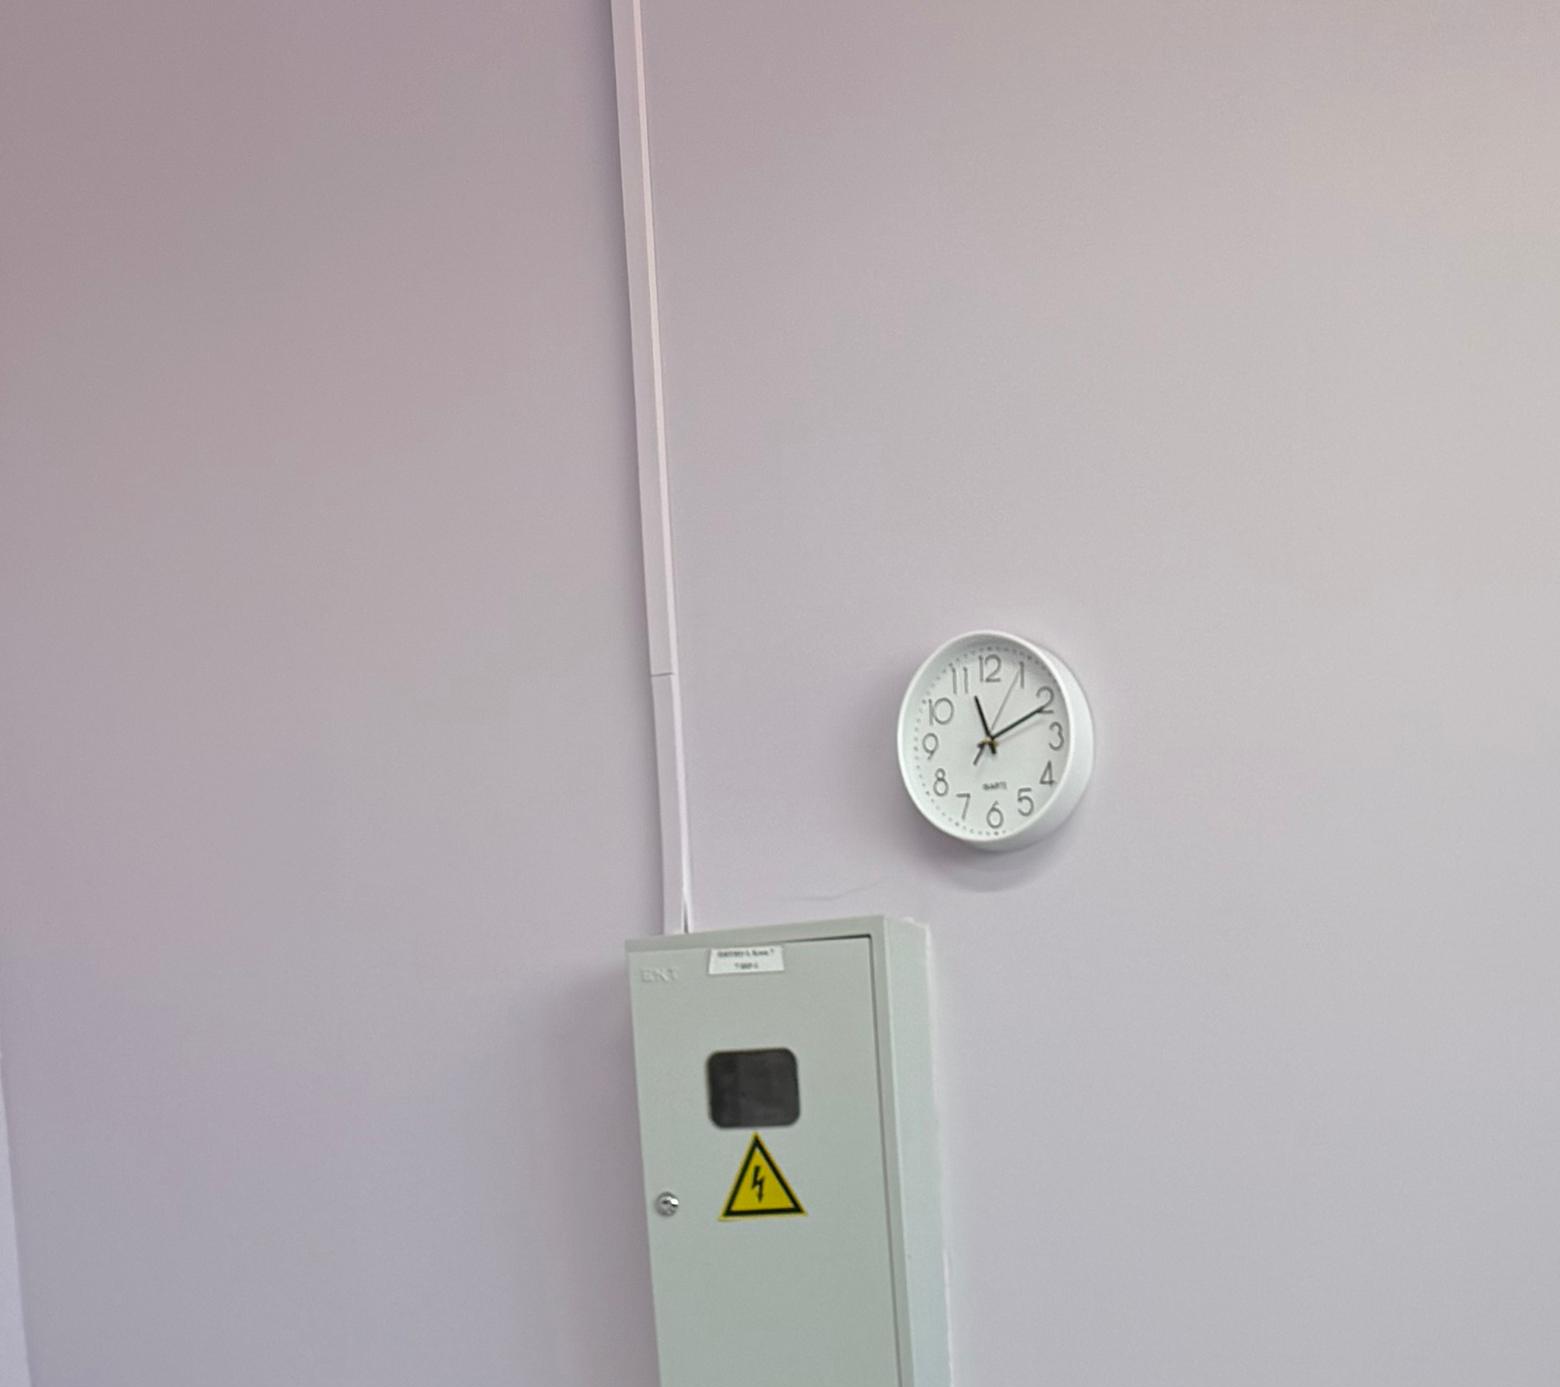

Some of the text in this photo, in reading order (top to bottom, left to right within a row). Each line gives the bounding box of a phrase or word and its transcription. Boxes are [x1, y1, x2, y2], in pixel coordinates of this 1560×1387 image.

[951, 666, 969, 695] 11
[978, 654, 1002, 683] 12
[1019, 661, 1025, 689] 1
[928, 698, 954, 726] 10
[1036, 686, 1055, 714] 2
[922, 732, 939, 760] 9
[1048, 722, 1065, 751] 3
[933, 767, 949, 797] 8
[1040, 760, 1057, 787] 4
[956, 793, 971, 820] 7
[987, 800, 1004, 829] 6
[1017, 788, 1035, 817] 5
